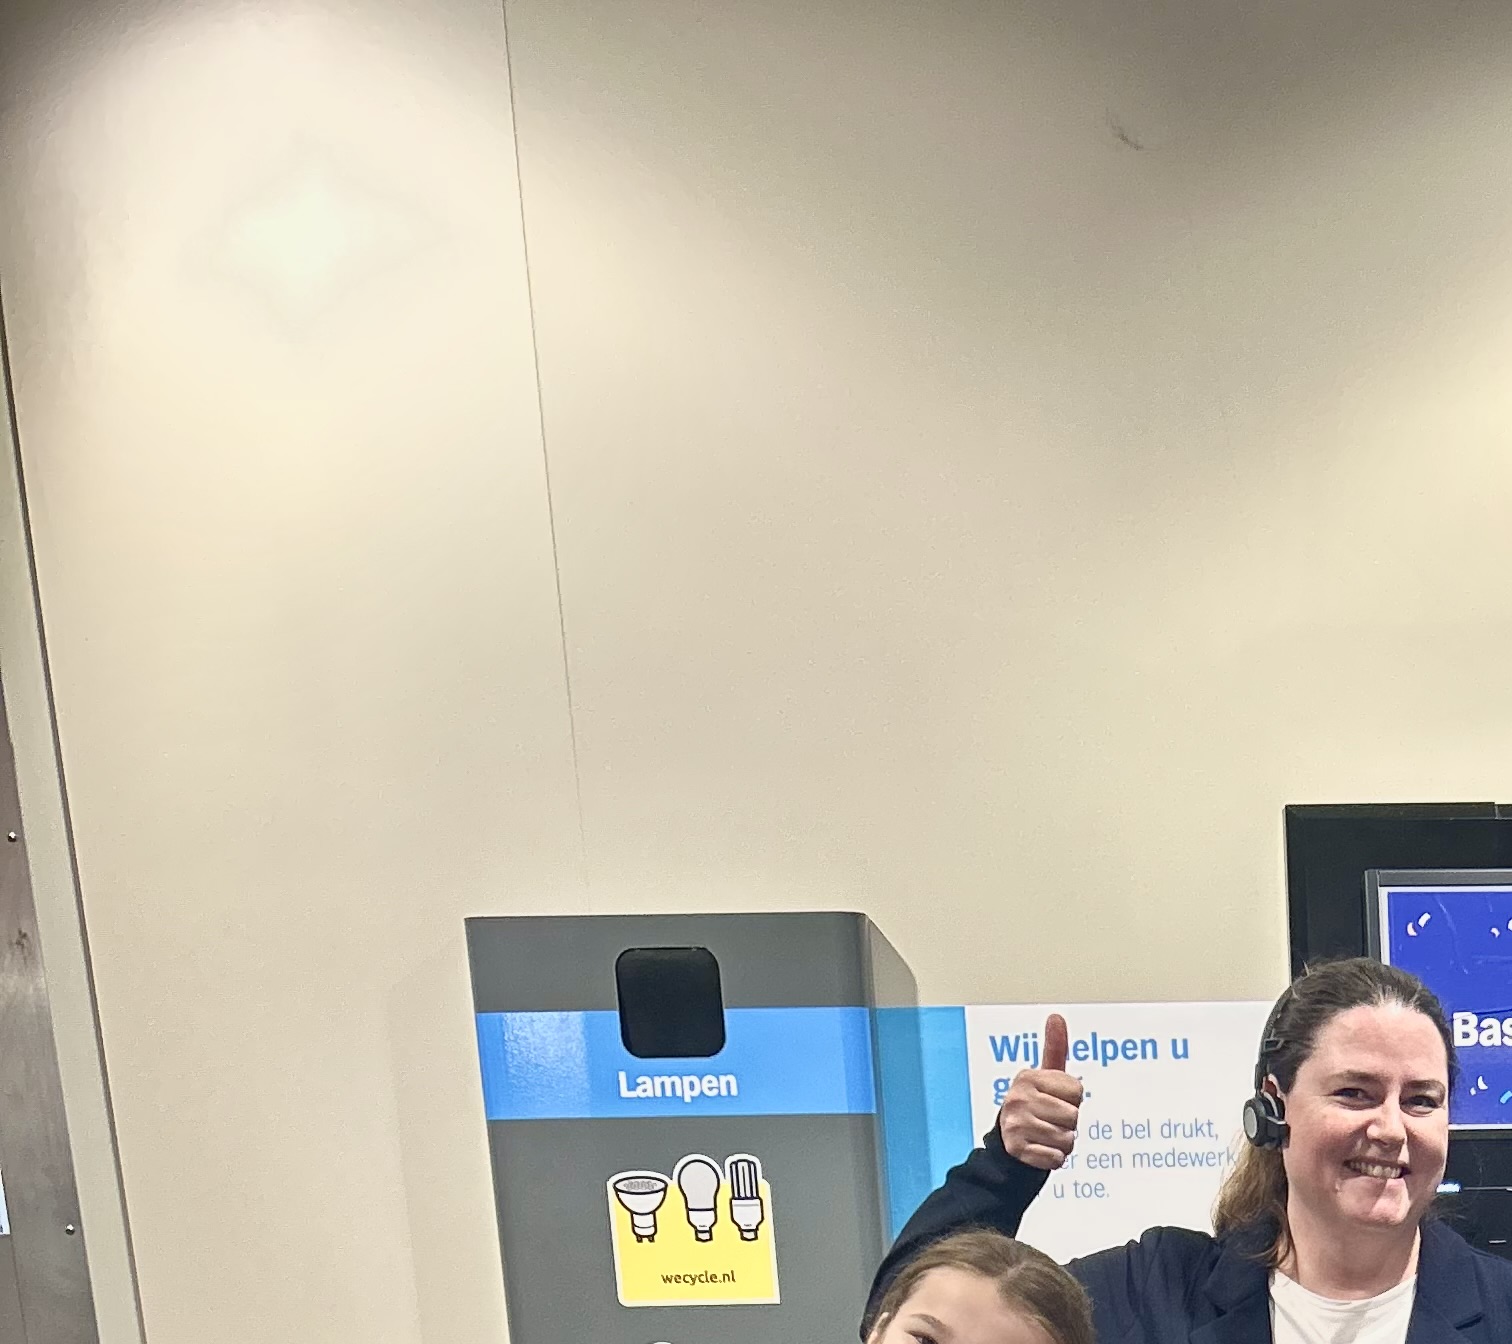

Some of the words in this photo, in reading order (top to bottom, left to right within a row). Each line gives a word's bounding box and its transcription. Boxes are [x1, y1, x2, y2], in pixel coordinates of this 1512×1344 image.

[989, 1033, 1039, 1069] Wij
[1171, 1037, 1189, 1059] u
[618, 1071, 739, 1103] Lampen
[1088, 1120, 1113, 1140] de
[1122, 1119, 1151, 1139] bel
[1160, 1117, 1219, 1141] drukt,
[1086, 1152, 1123, 1169] een
[1132, 1146, 1236, 1168] medewerk
[1053, 1184, 1064, 1198] u
[1073, 1179, 1110, 1199] toe.
[661, 1270, 736, 1287] wecycle.nl
